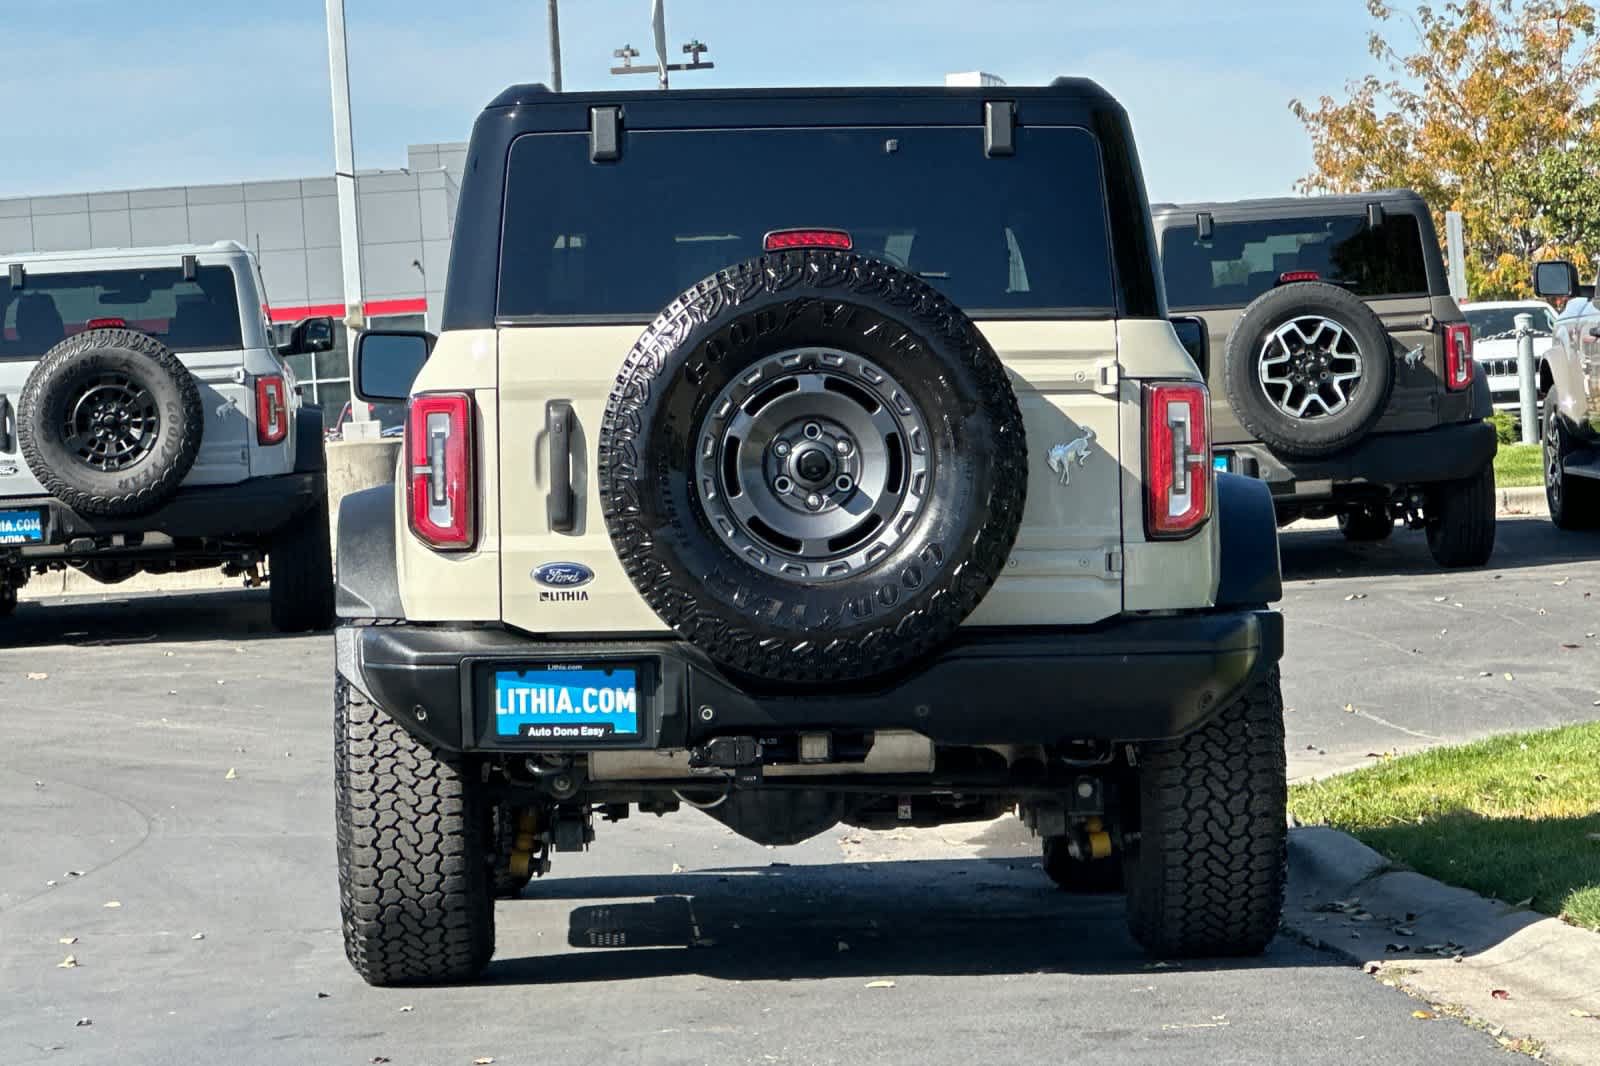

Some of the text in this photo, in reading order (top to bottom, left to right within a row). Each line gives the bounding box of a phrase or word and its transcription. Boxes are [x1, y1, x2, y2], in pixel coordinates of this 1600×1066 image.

[550, 591, 589, 601] LITHIA
[495, 687, 637, 714] LITHIA.COM
[527, 726, 605, 738] Auto Done Easy
